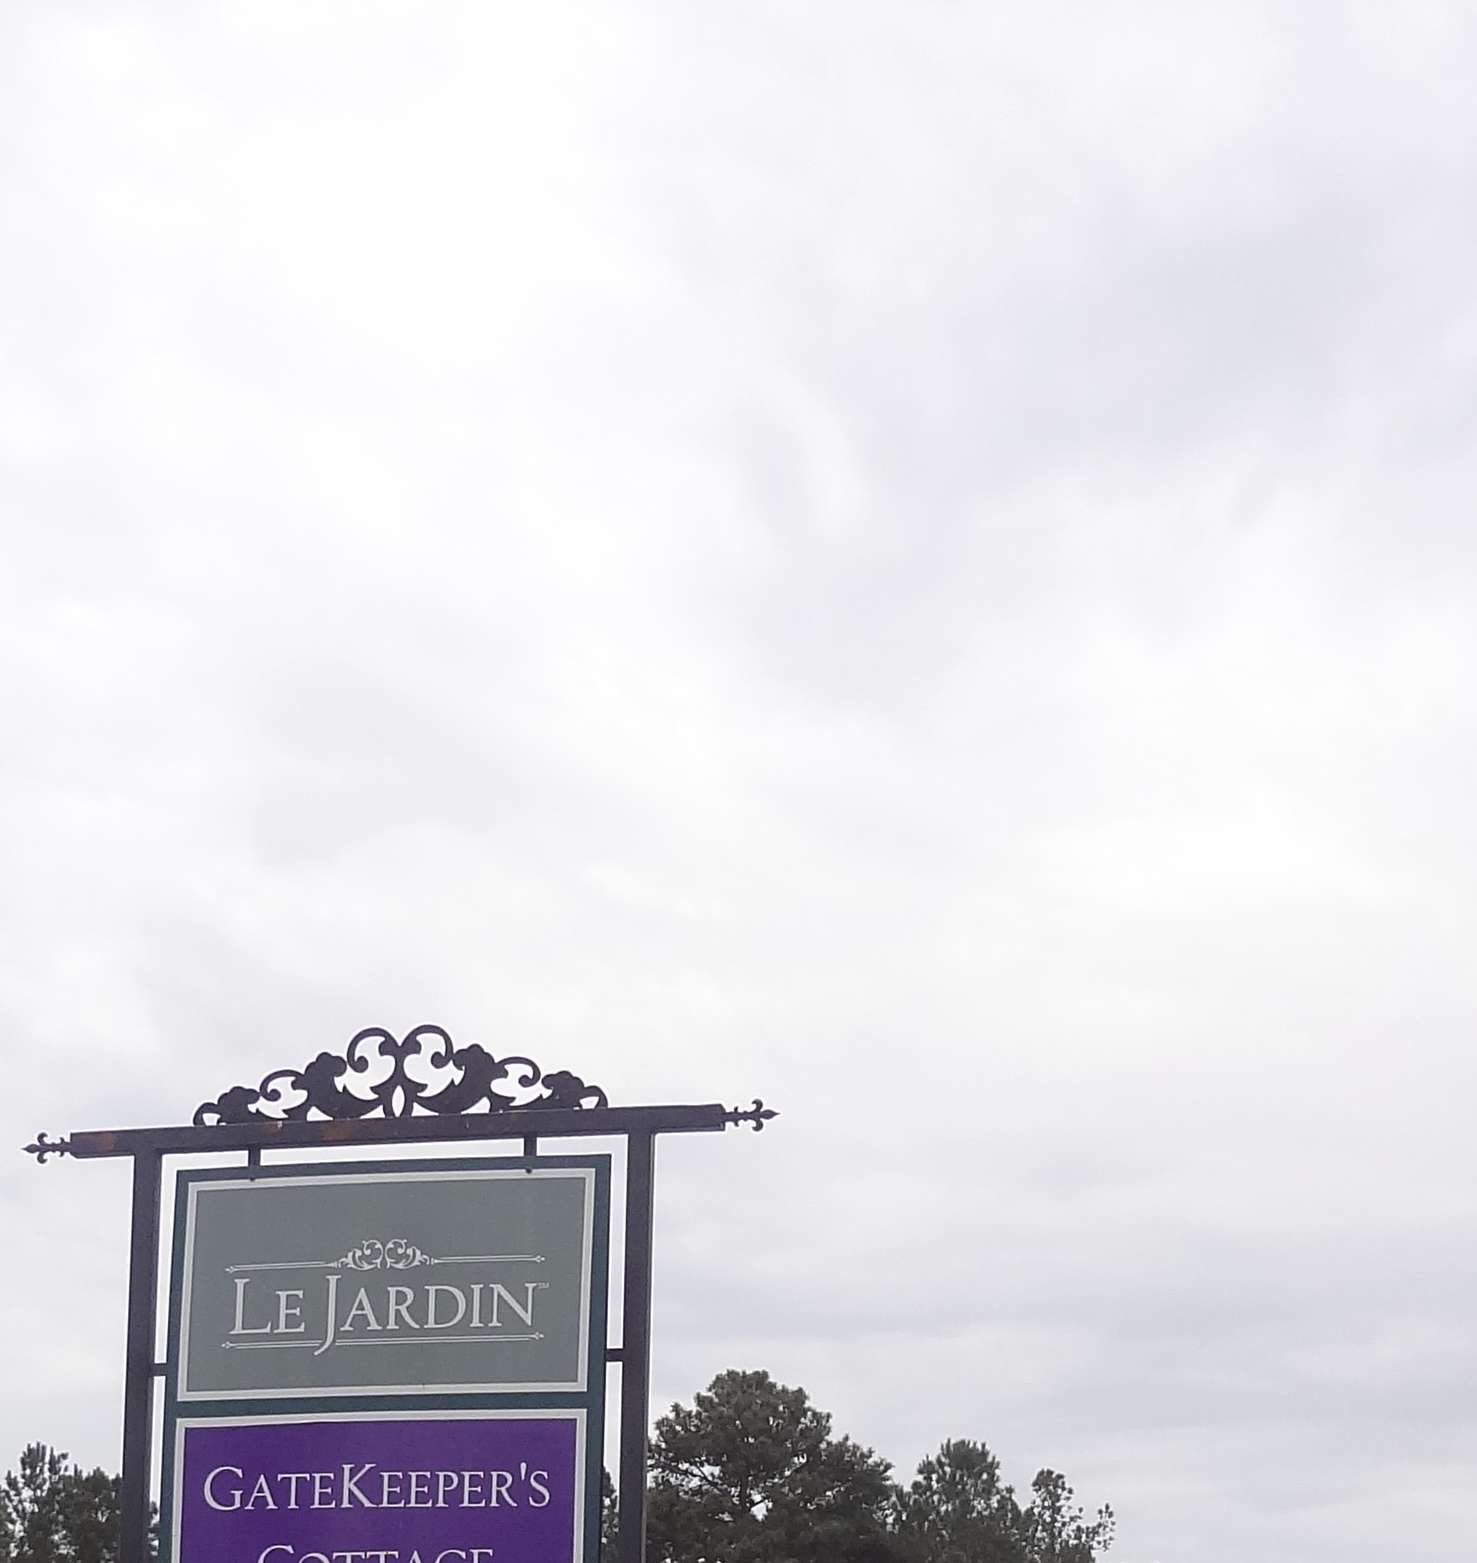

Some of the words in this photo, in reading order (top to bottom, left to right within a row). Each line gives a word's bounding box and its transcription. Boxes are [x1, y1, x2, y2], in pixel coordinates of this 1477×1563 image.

[228, 1278, 305, 1335] LE
[313, 1275, 537, 1356] JARDIN
[204, 1462, 550, 1511] GATEKEEPER'S
